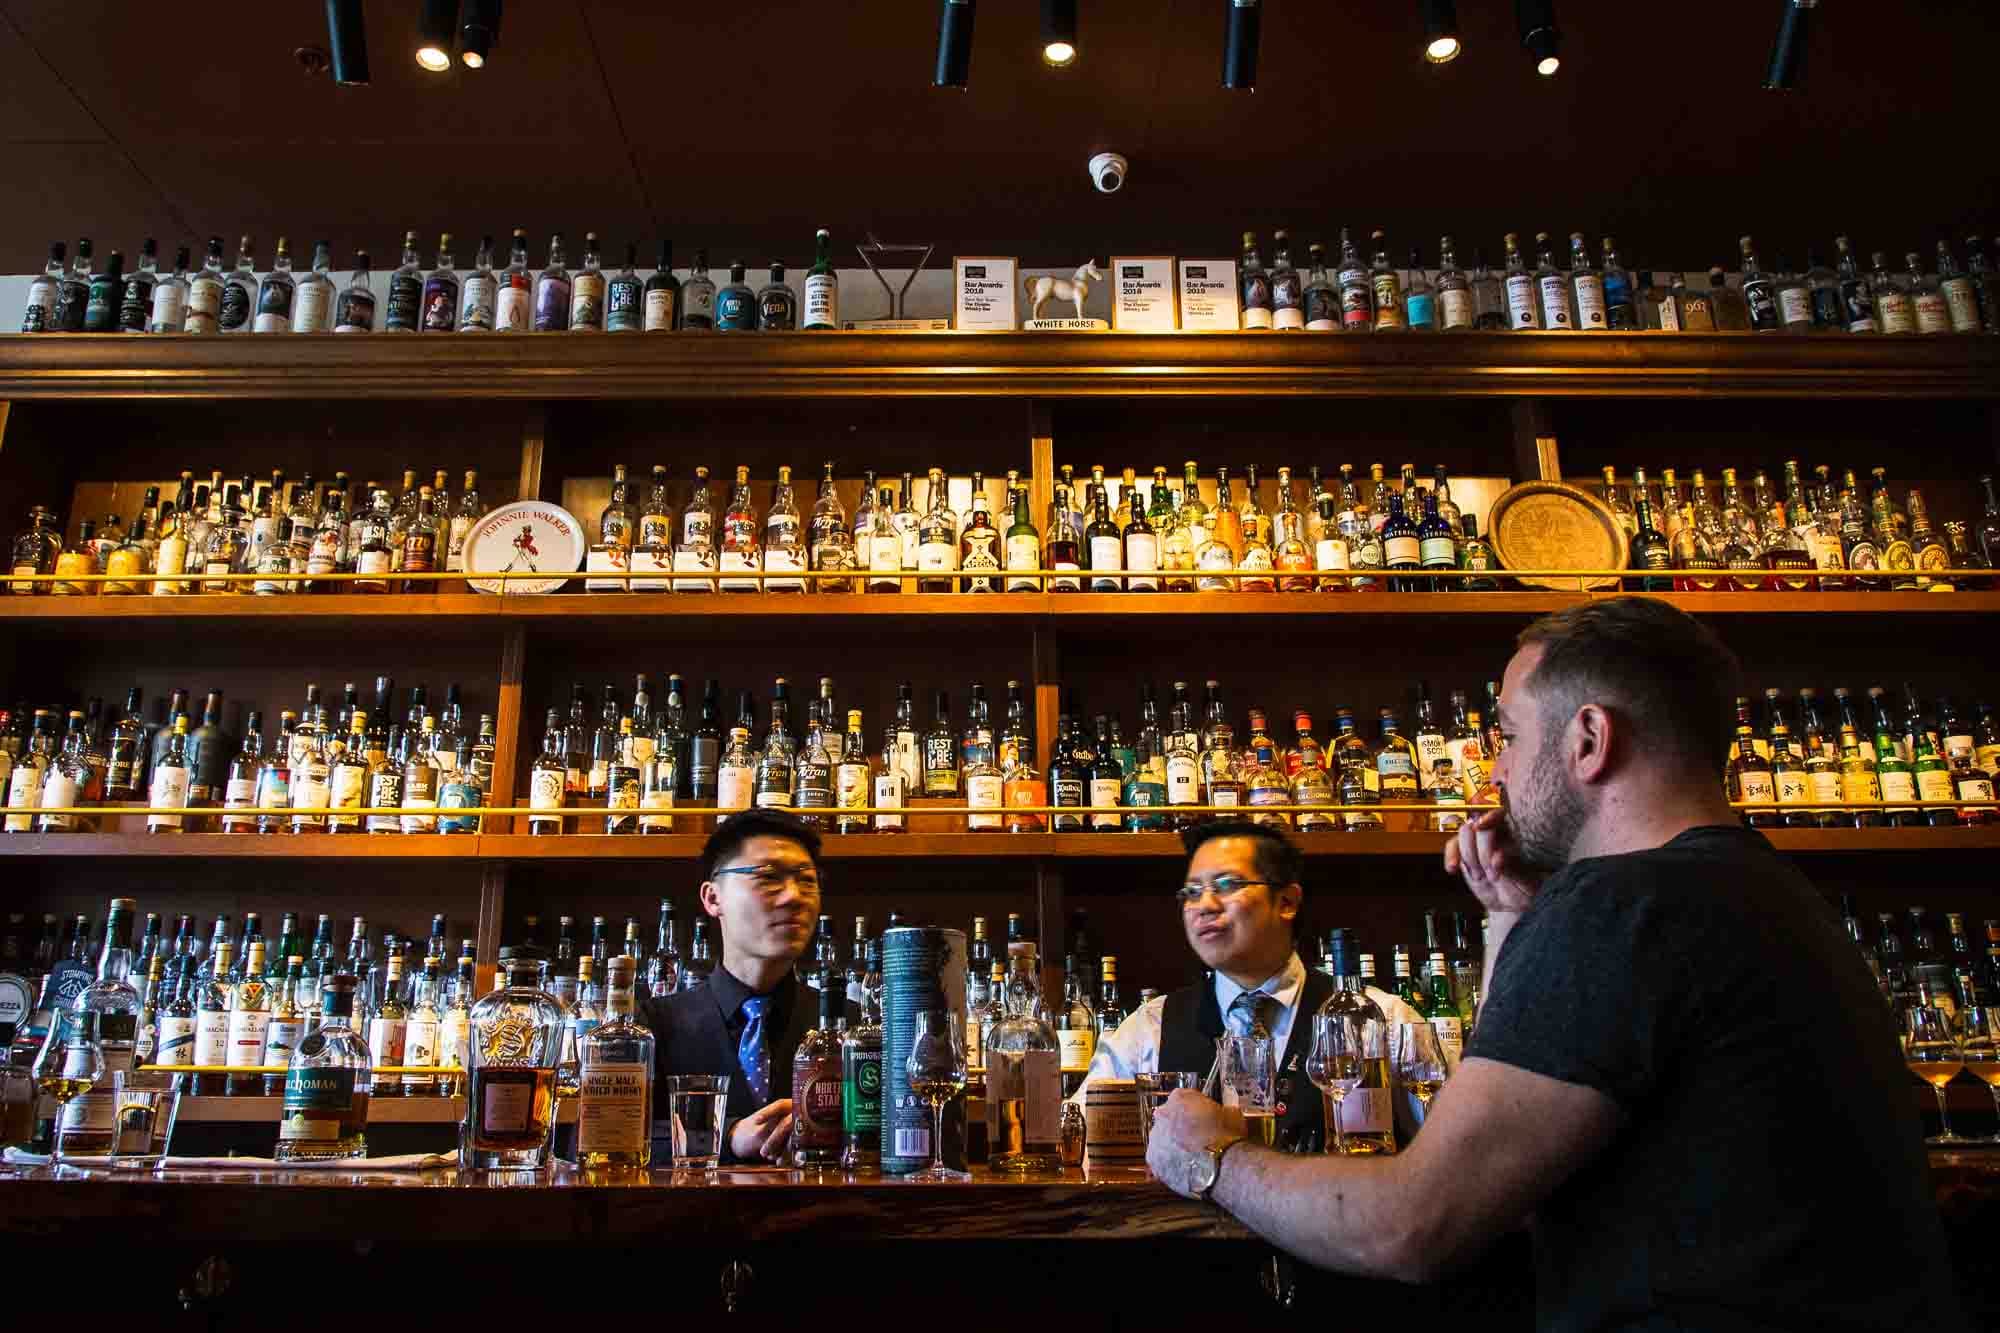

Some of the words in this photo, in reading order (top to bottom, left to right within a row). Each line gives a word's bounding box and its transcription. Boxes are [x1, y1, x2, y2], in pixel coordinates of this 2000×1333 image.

[977, 281, 1003, 289] Awards
[1033, 320, 1065, 329] WHITE
[1068, 320, 1096, 329] HORSE
[481, 511, 529, 537] JOHNNIE
[533, 511, 570, 537] WALKER
[928, 738, 953, 750] REST
